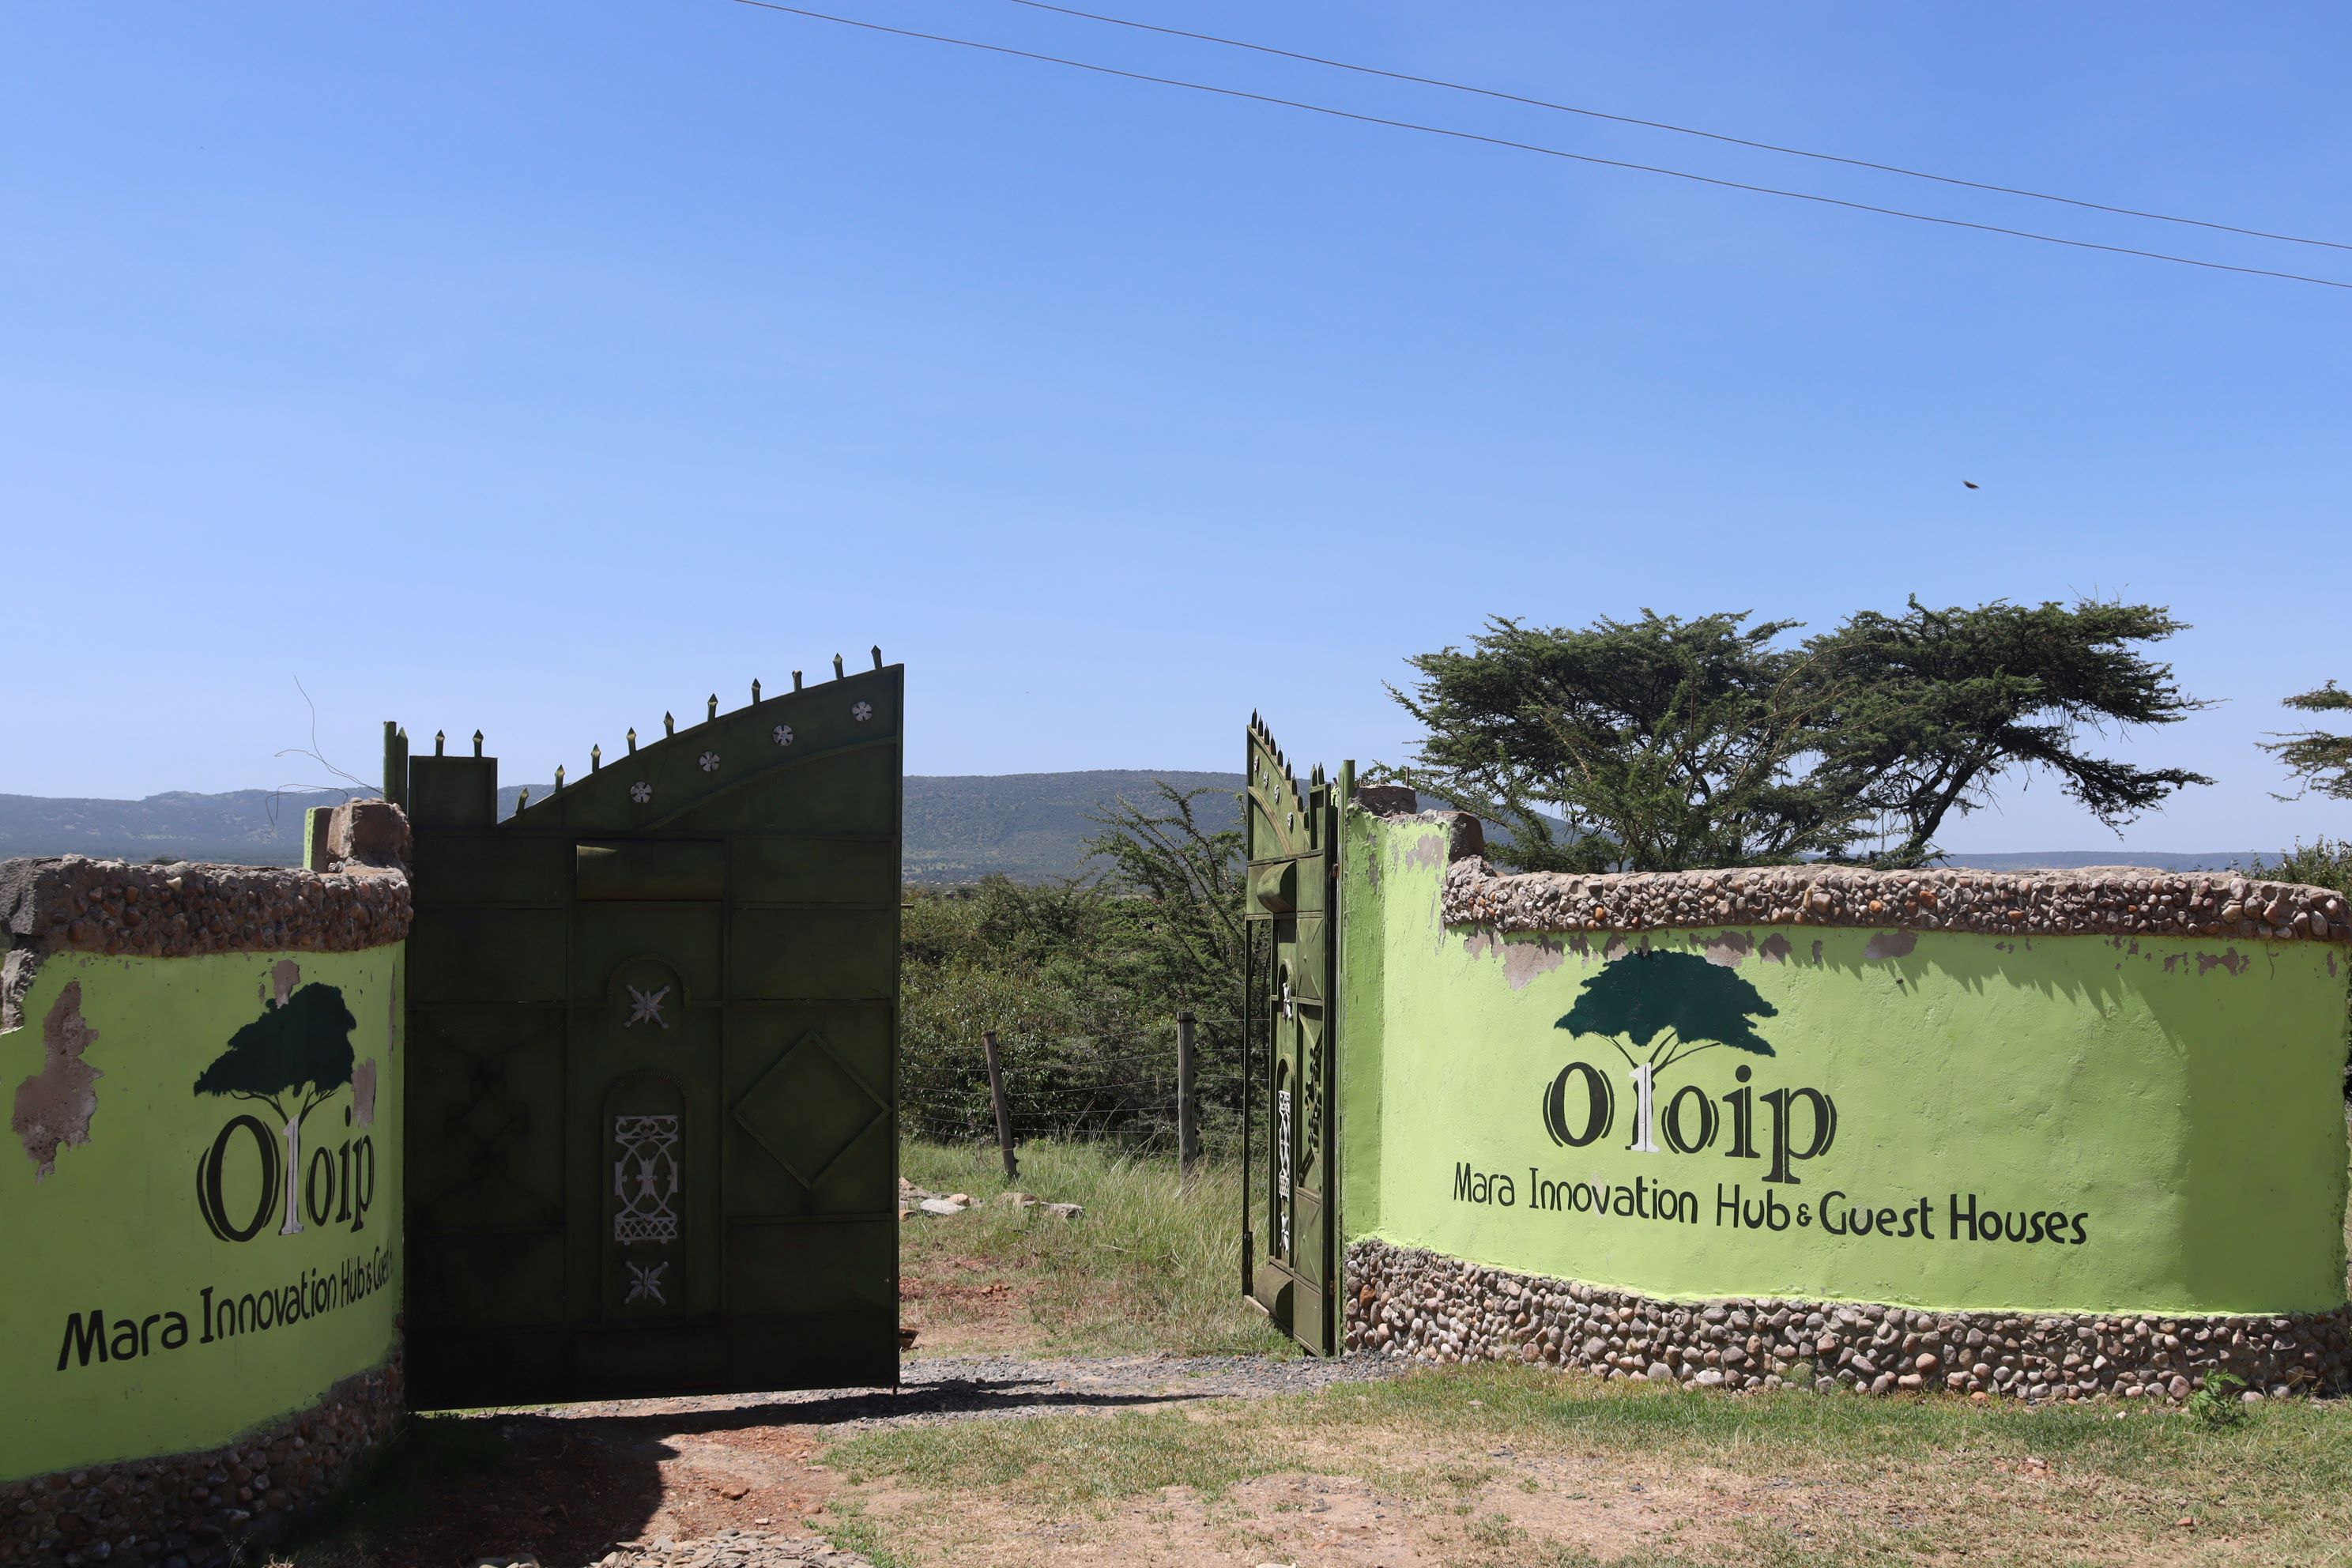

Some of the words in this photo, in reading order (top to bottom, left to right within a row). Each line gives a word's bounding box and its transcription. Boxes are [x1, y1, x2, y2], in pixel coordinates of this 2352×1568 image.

[196, 1105, 375, 1242] Oloip
[1543, 1061, 1838, 1184] Oloip
[1453, 1162, 1515, 1207] Mara
[1528, 1167, 1698, 1224] Innovation
[1716, 1183, 1791, 1232] Hub
[1796, 1203, 1813, 1227] &
[1819, 1190, 1935, 1240] Guest
[1950, 1193, 2089, 1245] Houses
[57, 1310, 189, 1371] Mara
[200, 1268, 337, 1344] Innovation
[341, 1255, 365, 1308] Hub
